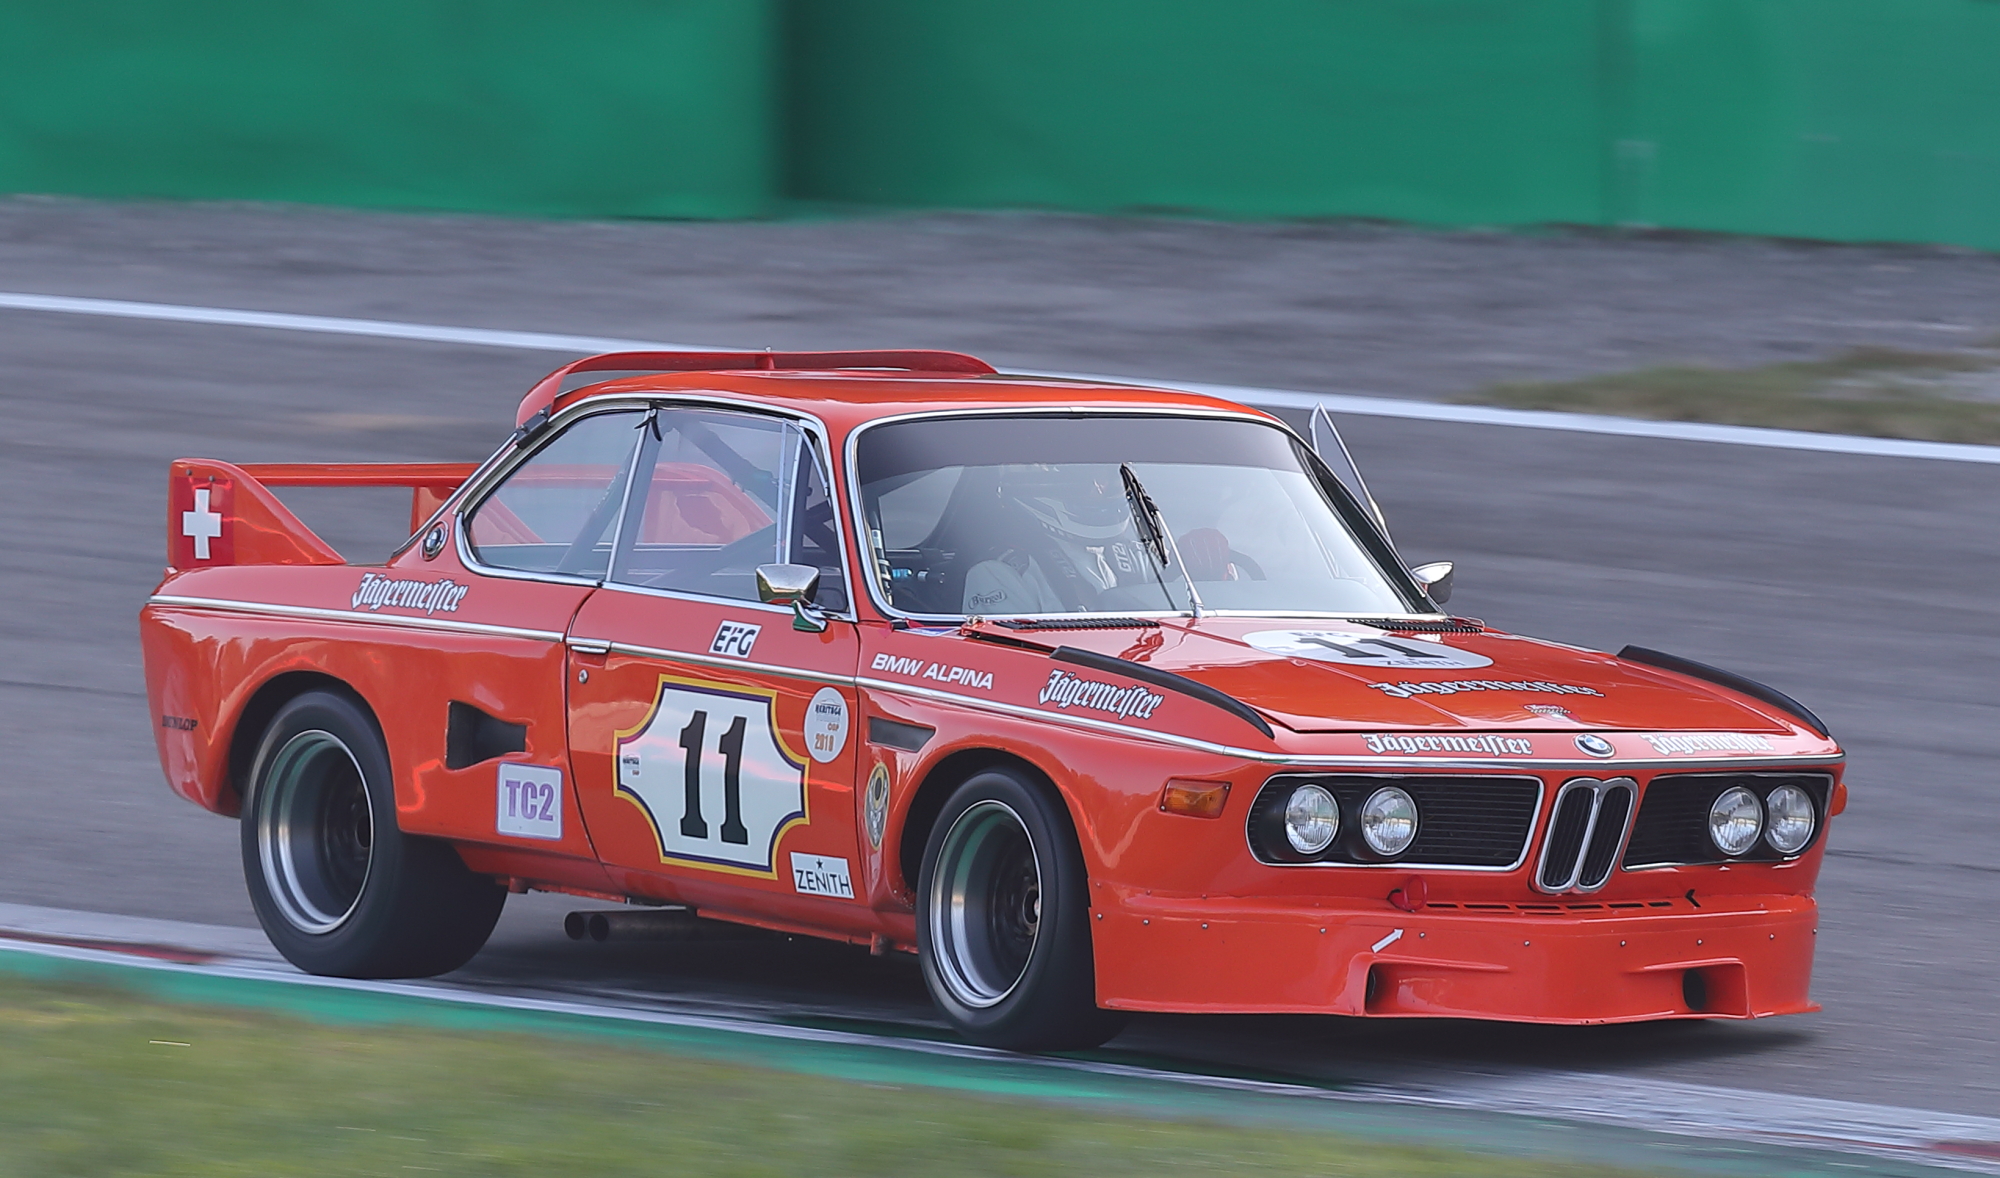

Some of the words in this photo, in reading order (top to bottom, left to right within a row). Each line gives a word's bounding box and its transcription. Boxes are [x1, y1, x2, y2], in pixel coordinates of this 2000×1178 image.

[713, 625, 757, 655] EFG
[1294, 638, 1448, 659] 11
[871, 653, 924, 676] BMW
[922, 662, 993, 690] ALPINA
[679, 710, 748, 845] 11
[505, 780, 555, 821] TC2
[795, 869, 852, 896] ZENITH
